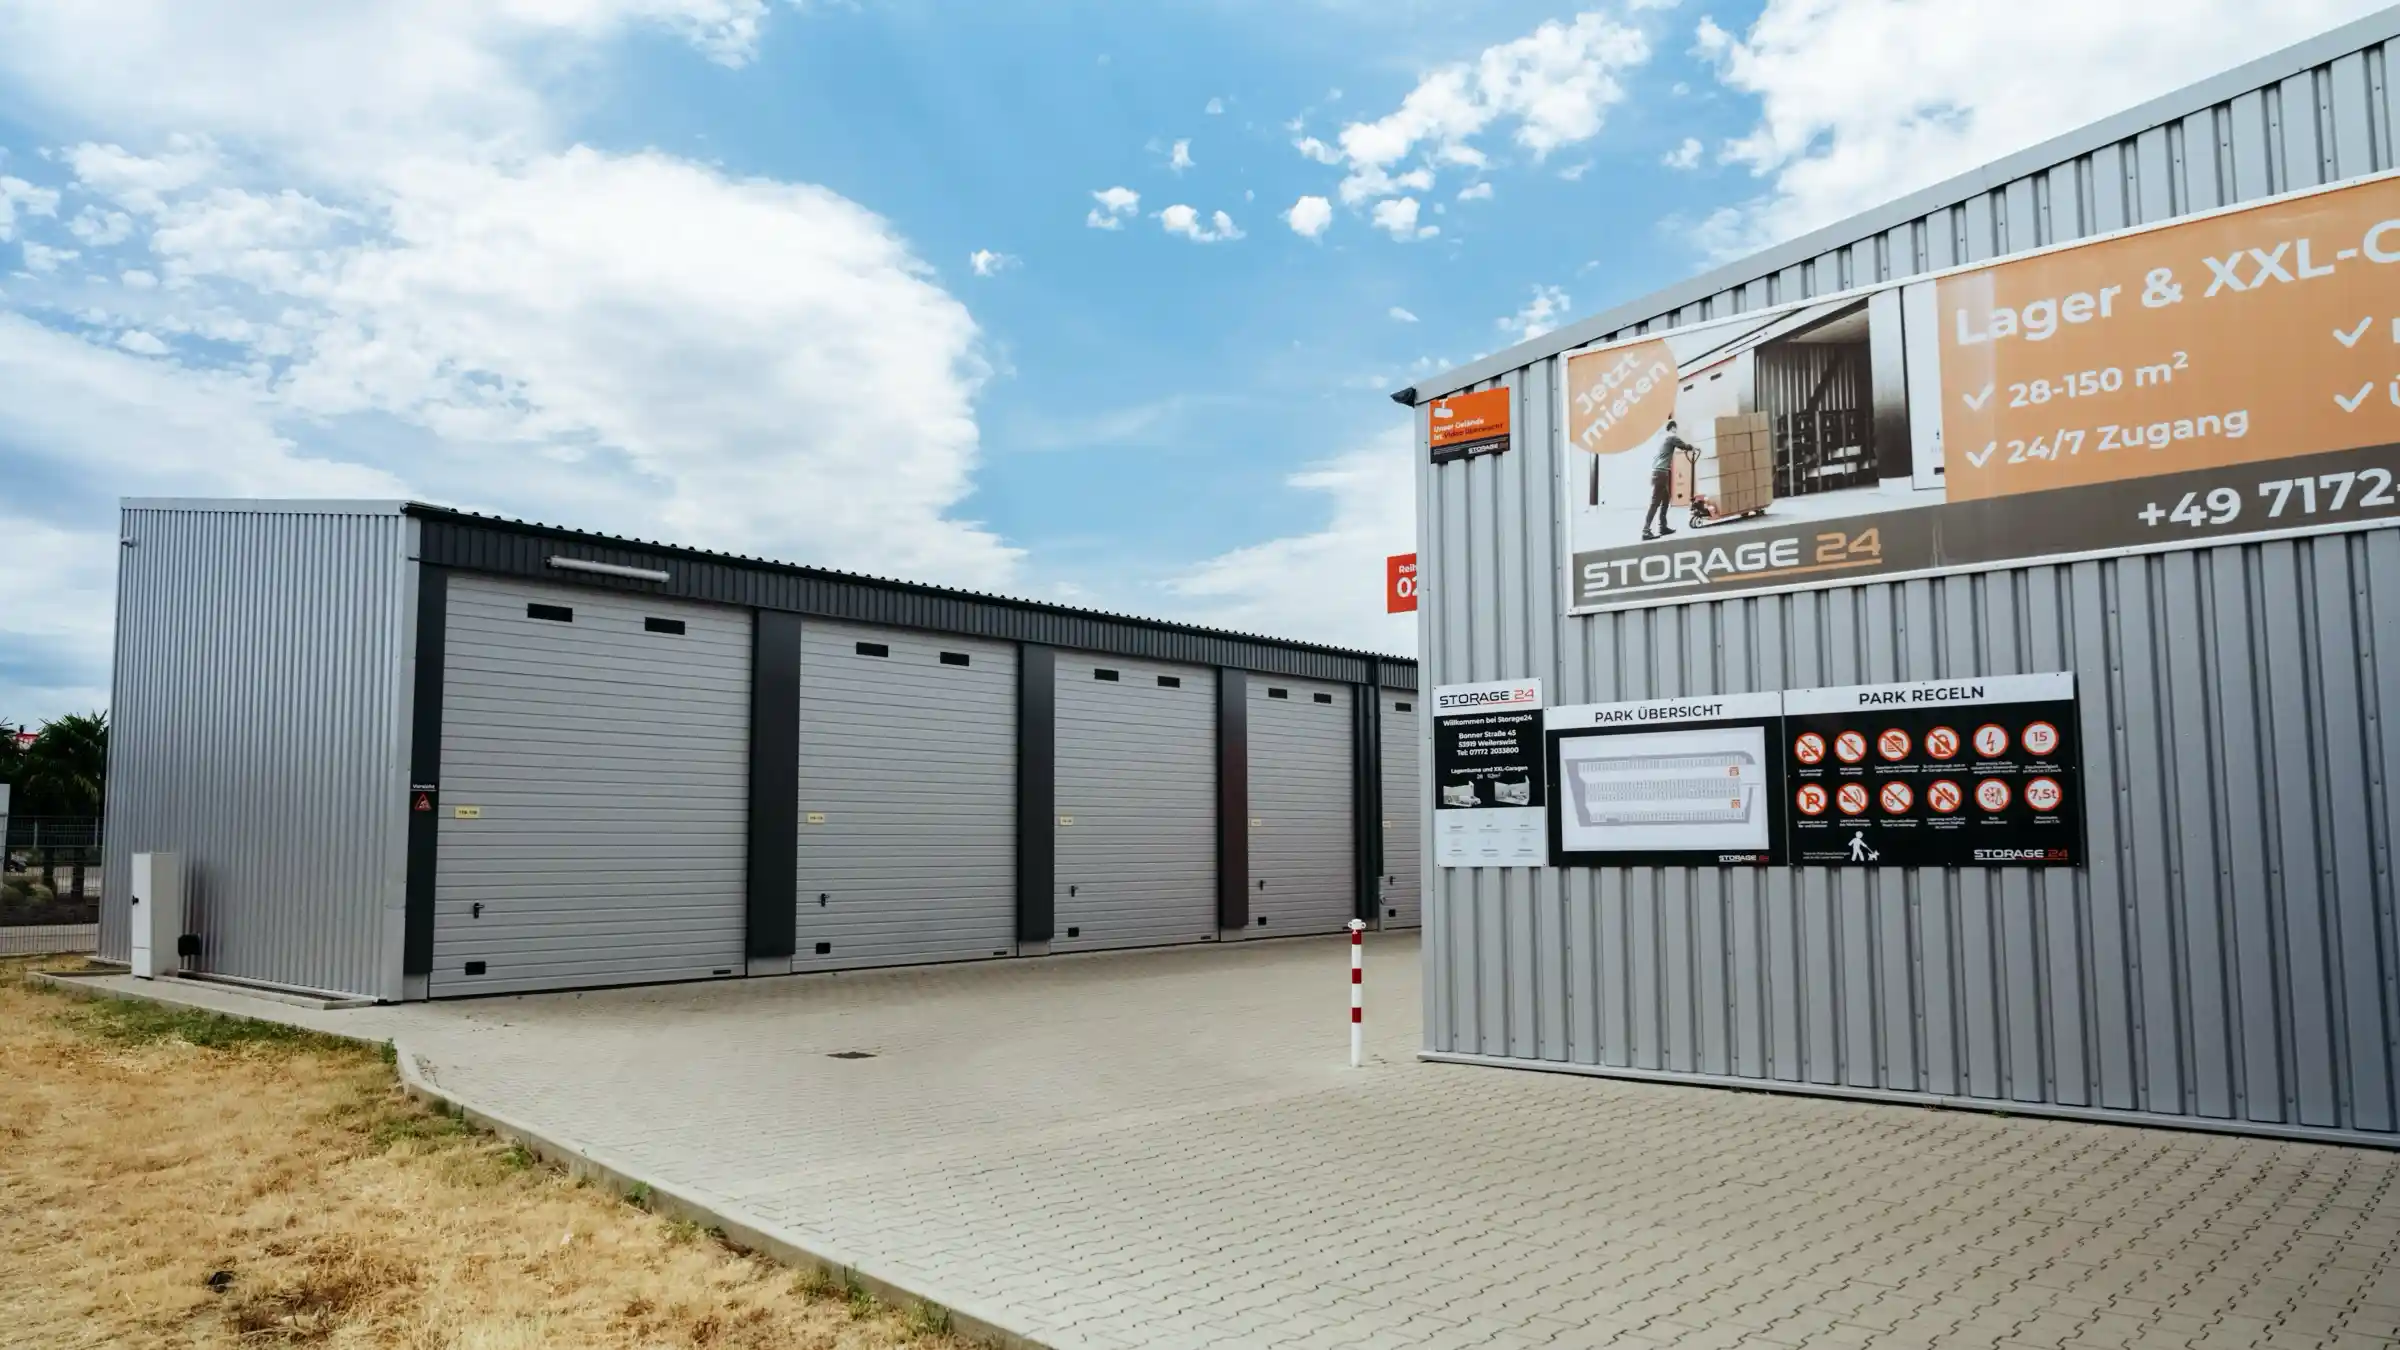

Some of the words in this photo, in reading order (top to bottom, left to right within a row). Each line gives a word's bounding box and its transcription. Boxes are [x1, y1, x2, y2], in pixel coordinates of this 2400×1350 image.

[1956, 283, 2122, 345] Lager
[2142, 267, 2183, 308] &
[1575, 351, 1640, 415] Jetzt
[2008, 367, 2123, 409] 28-150
[2136, 351, 2189, 387] m²
[1581, 360, 1669, 448] mieten
[2007, 429, 2085, 465] 24/7
[2097, 409, 2249, 450] Zugang
[2138, 487, 2241, 527] +49
[2258, 468, 2400, 518] 7172
[1583, 538, 1800, 592] STORAGE
[1815, 528, 1882, 563] 24
[1440, 691, 1510, 706] STORAGE
[1514, 688, 1535, 701] 24
[1859, 691, 1906, 705] PARK
[1912, 685, 1985, 702] REGELN
[1443, 717, 1485, 727] Willkommen
[1485, 716, 1497, 724] bei
[1497, 714, 1533, 724] Storage24
[1595, 709, 1633, 723] PARK
[1638, 703, 1723, 720] ÜBERSICHT
[1458, 732, 1483, 740] Bonner
[1484, 730, 1506, 738] Straße
[1478, 738, 1517, 747] Weilerswist
[2032, 731, 2048, 742] 15
[1469, 748, 1488, 756] 07172
[2030, 788, 2057, 801] 7,5t
[1719, 854, 1757, 862] STORAGE
[1974, 849, 2044, 859] STORAGE
